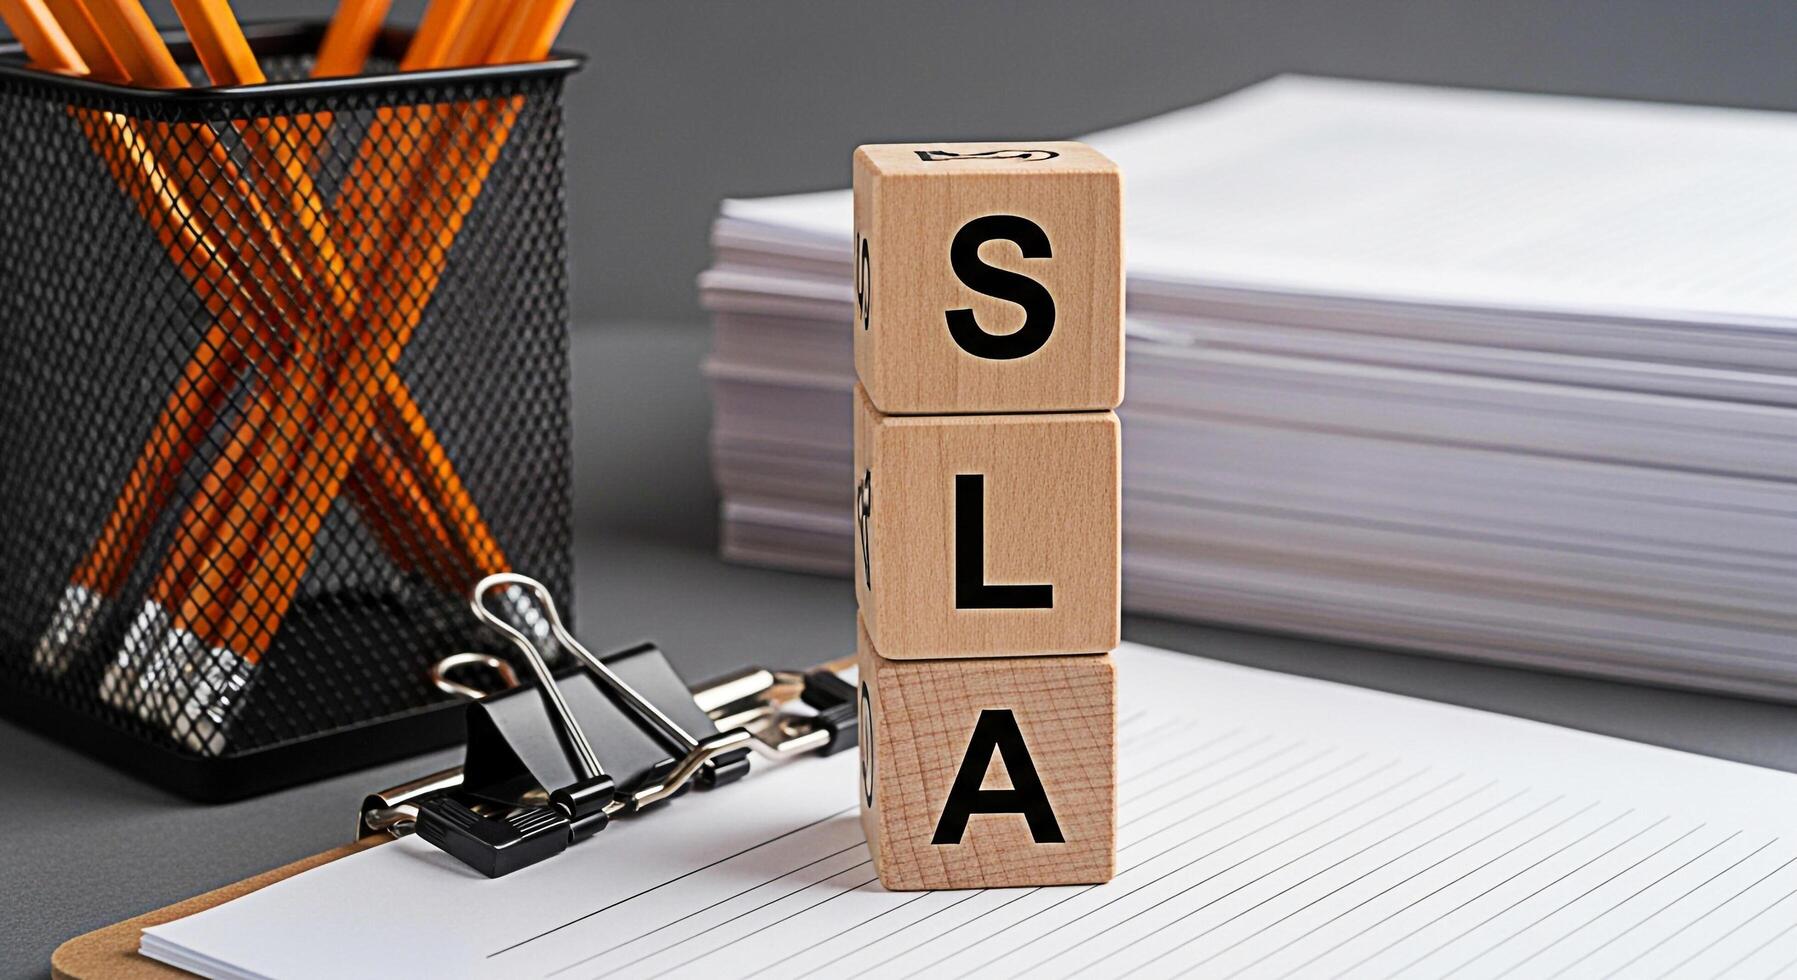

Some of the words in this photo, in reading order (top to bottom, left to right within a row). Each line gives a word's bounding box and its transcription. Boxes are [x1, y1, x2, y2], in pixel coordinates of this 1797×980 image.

[945, 214, 1056, 360] S
[955, 474, 1054, 610] L
[931, 709, 1066, 845] A
